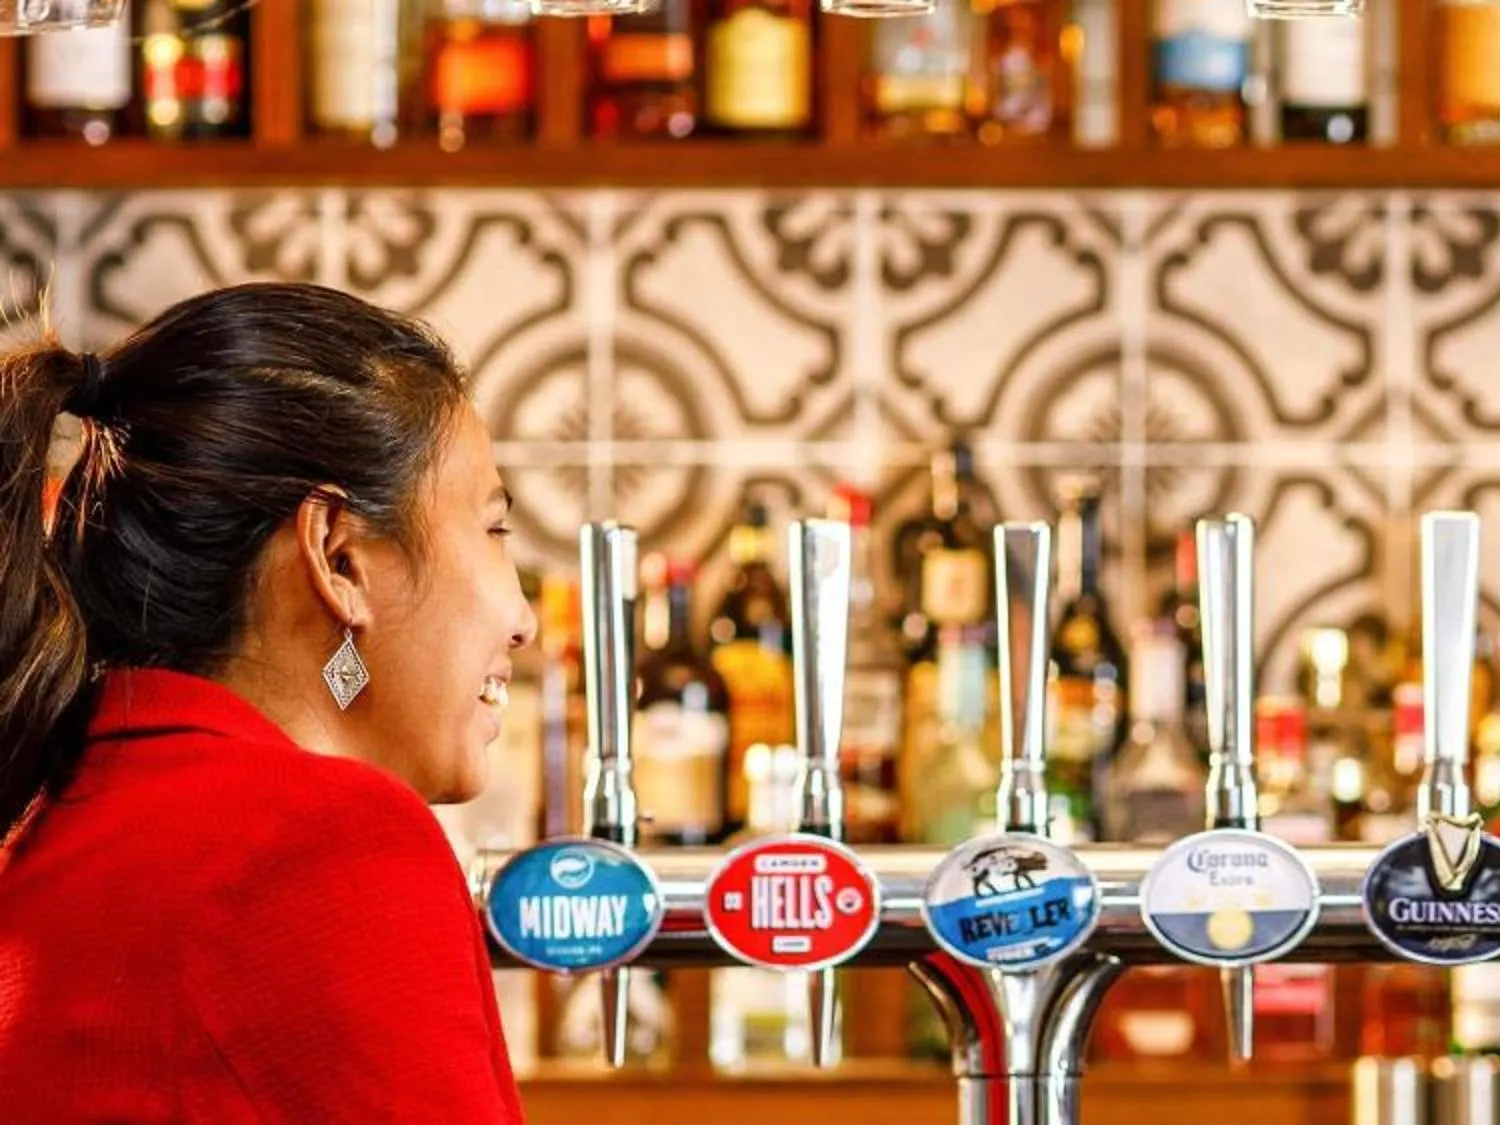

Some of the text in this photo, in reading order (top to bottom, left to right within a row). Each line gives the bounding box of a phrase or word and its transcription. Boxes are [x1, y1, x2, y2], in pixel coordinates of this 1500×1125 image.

[1187, 849, 1269, 873] Corona
[518, 894, 628, 939] MIDWAY
[751, 874, 833, 929] HELLS
